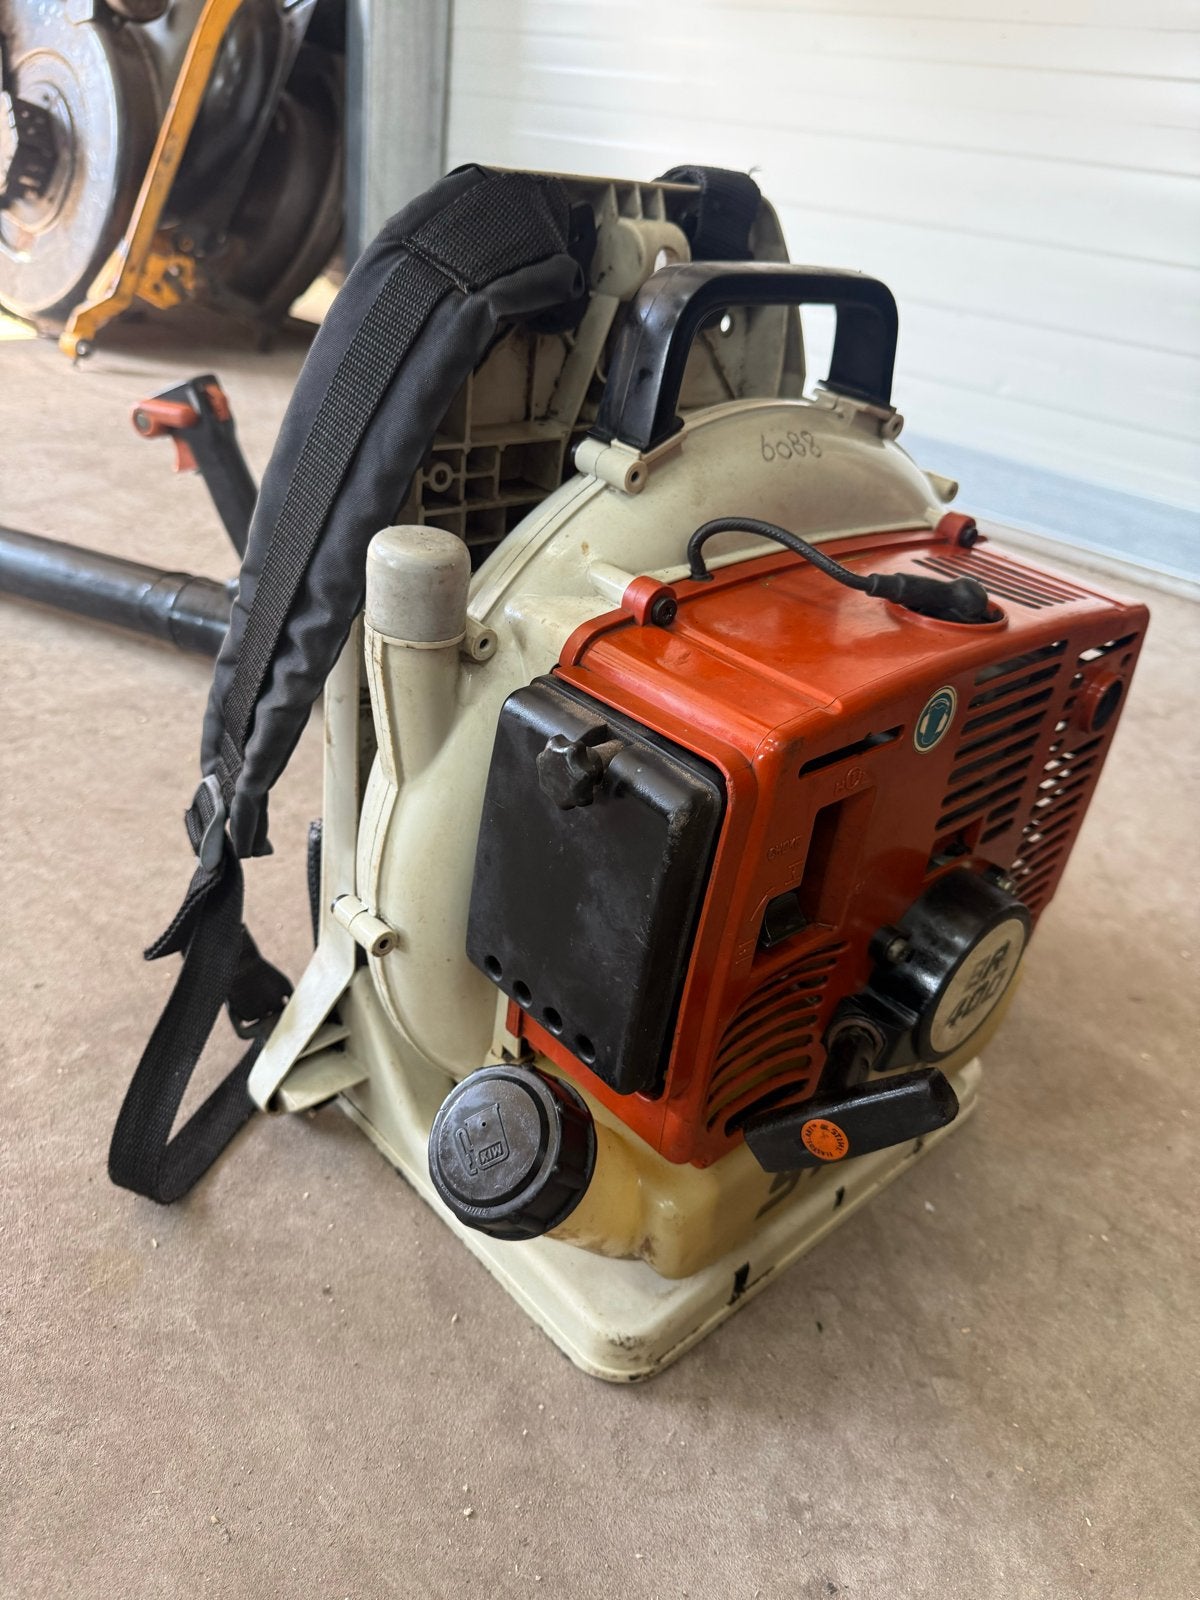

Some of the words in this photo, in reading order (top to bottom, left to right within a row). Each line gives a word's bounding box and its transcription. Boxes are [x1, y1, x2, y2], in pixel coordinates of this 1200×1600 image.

[760, 430, 823, 462] 6088
[964, 940, 1011, 993] BR
[945, 966, 1009, 1029] 400
[479, 1142, 504, 1165] MIX
